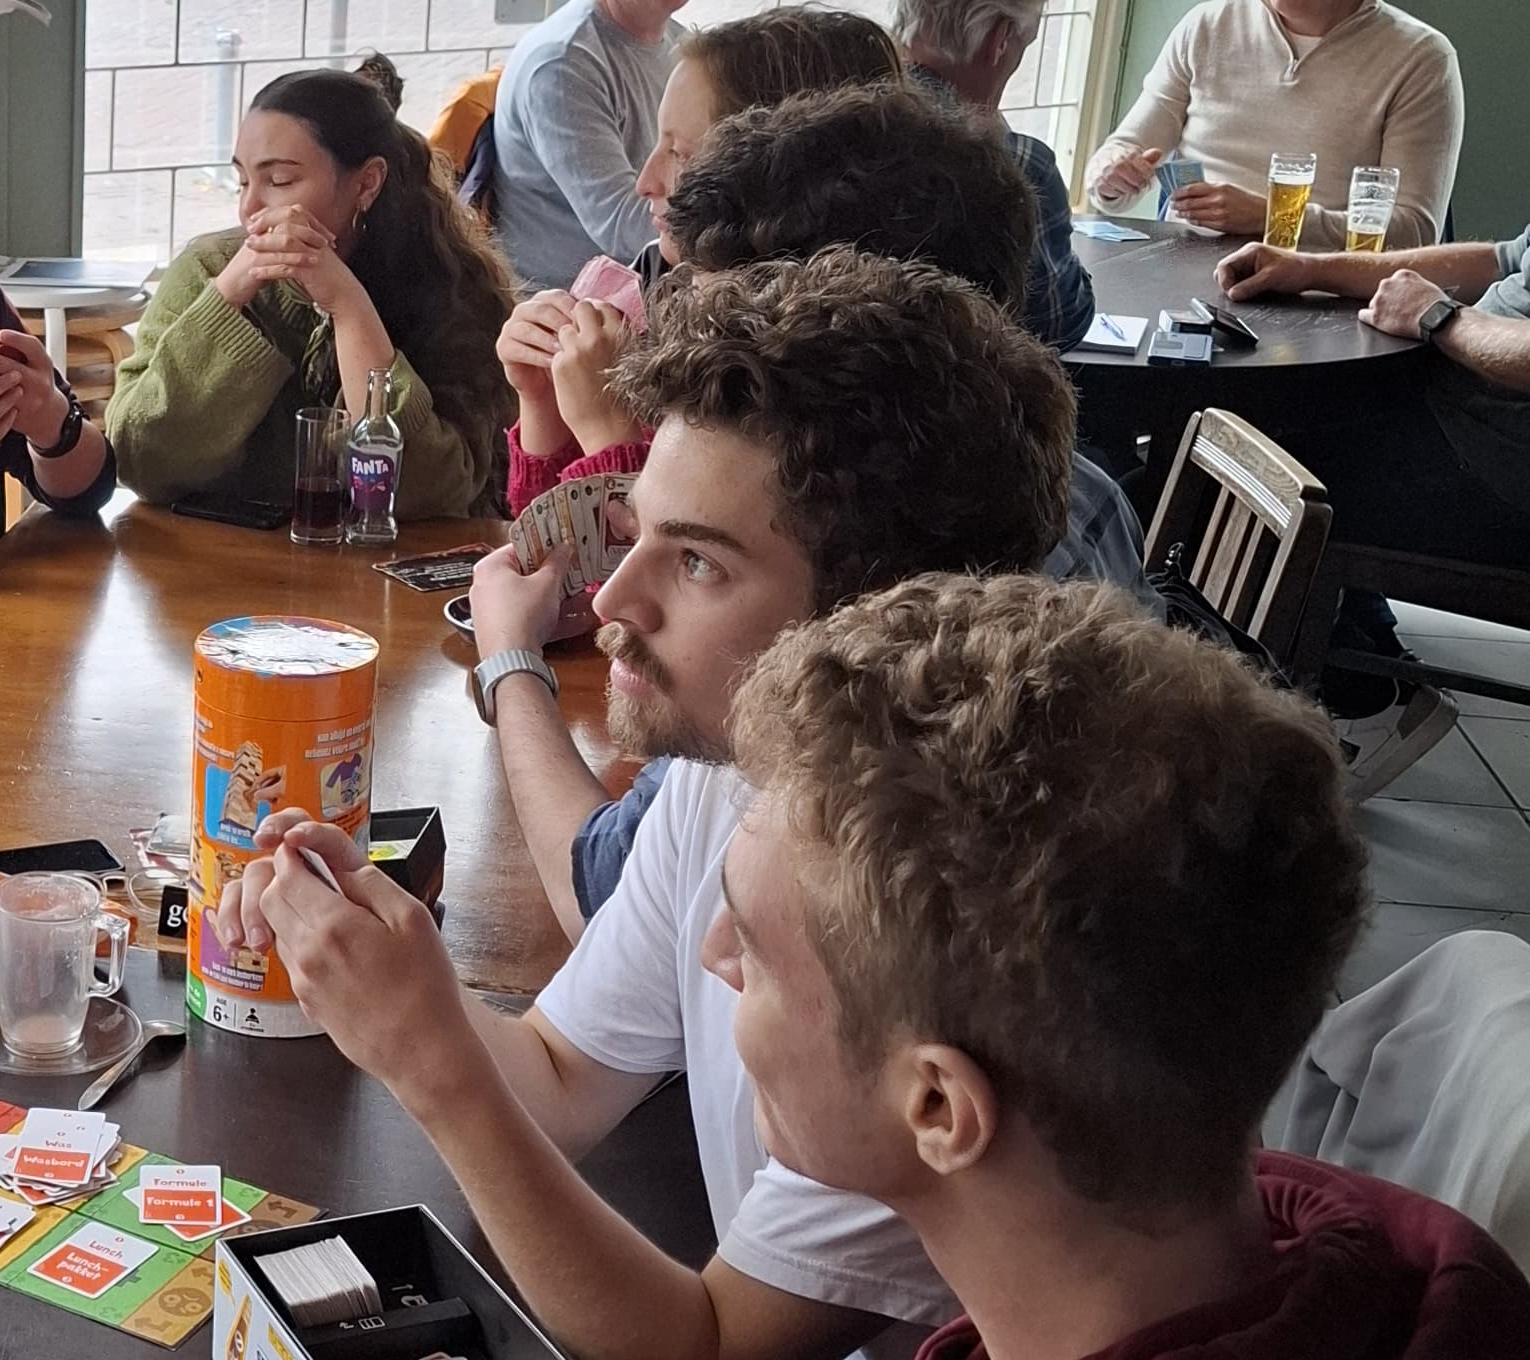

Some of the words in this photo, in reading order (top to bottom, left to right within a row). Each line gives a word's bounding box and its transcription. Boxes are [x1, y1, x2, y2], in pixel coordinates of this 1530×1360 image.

[351, 456, 389, 475] FANTA
[22, 1153, 86, 1168] Wasbord
[152, 1177, 208, 1188] Formule
[146, 1196, 203, 1208] Formule
[205, 1197, 215, 1208] 1
[88, 1239, 124, 1260] Lunch
[56, 1260, 102, 1281] pakket
